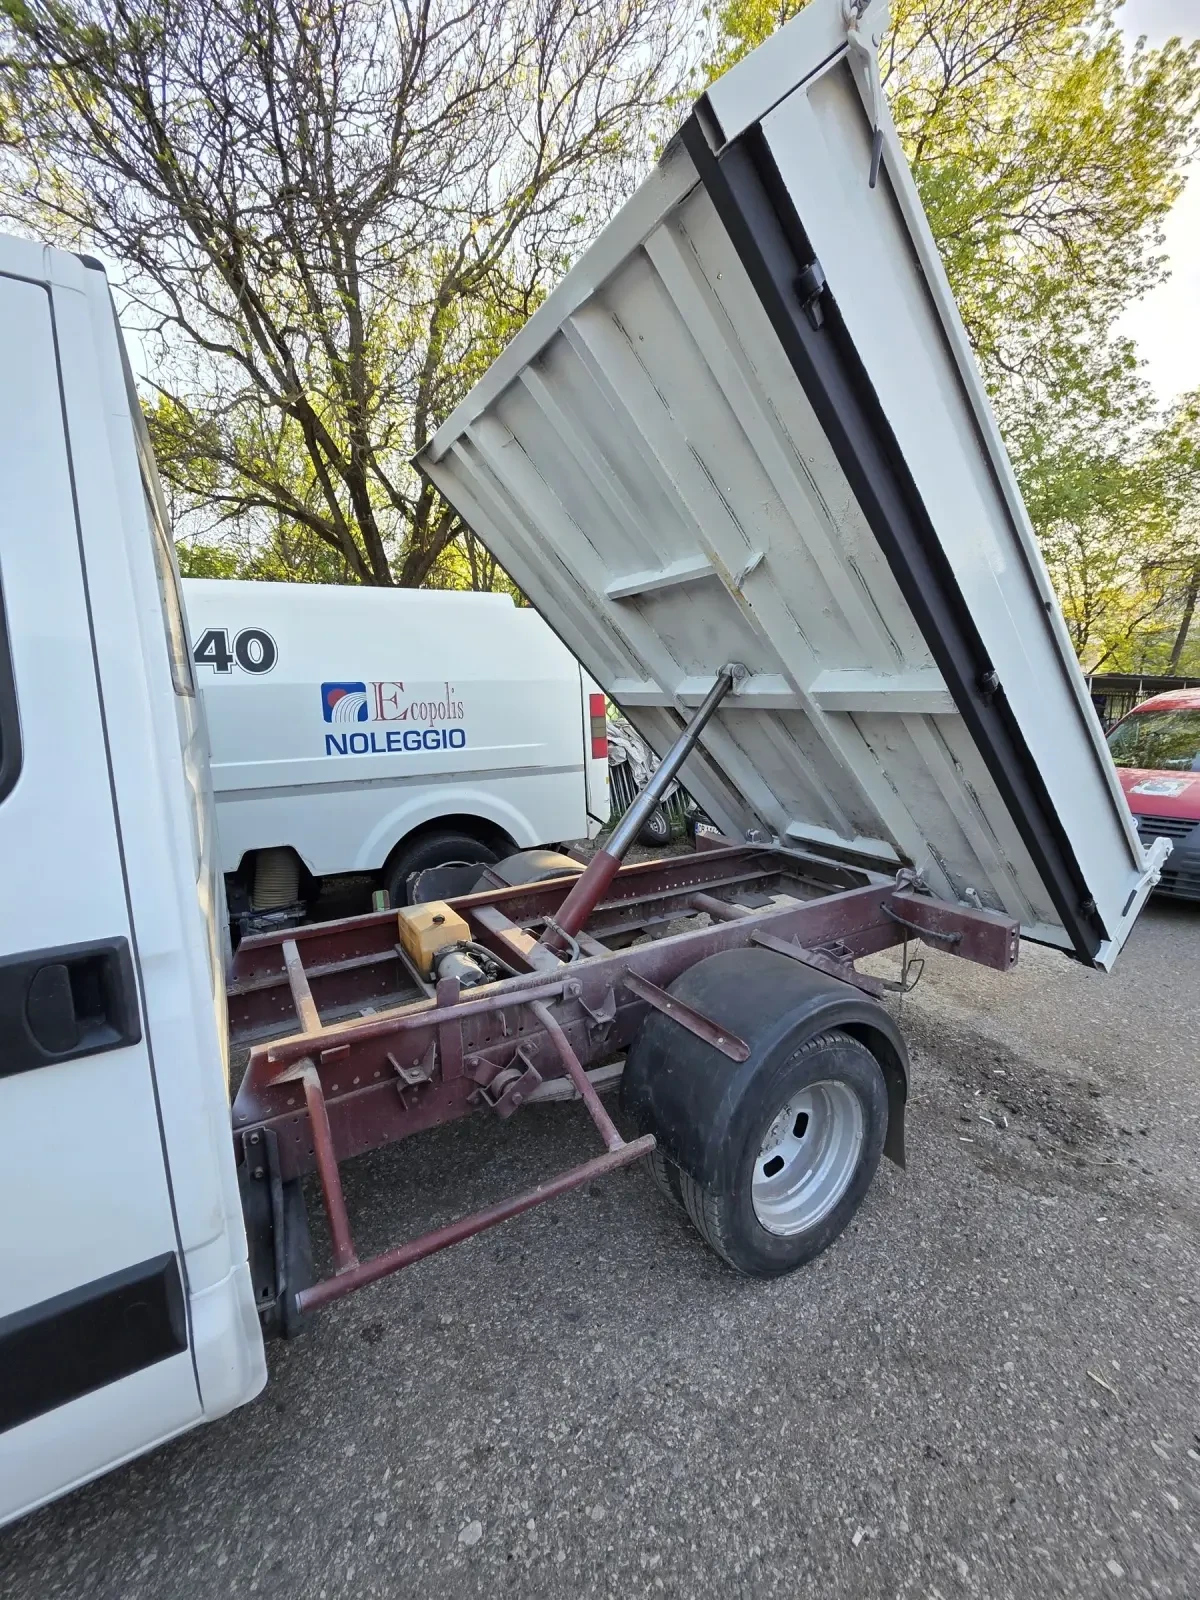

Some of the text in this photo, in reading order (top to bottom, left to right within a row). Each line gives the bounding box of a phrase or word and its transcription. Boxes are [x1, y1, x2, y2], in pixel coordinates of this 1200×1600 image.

[193, 627, 278, 675] 40
[369, 681, 464, 727] Ecopolis
[325, 729, 466, 755] NOLEGGIO
